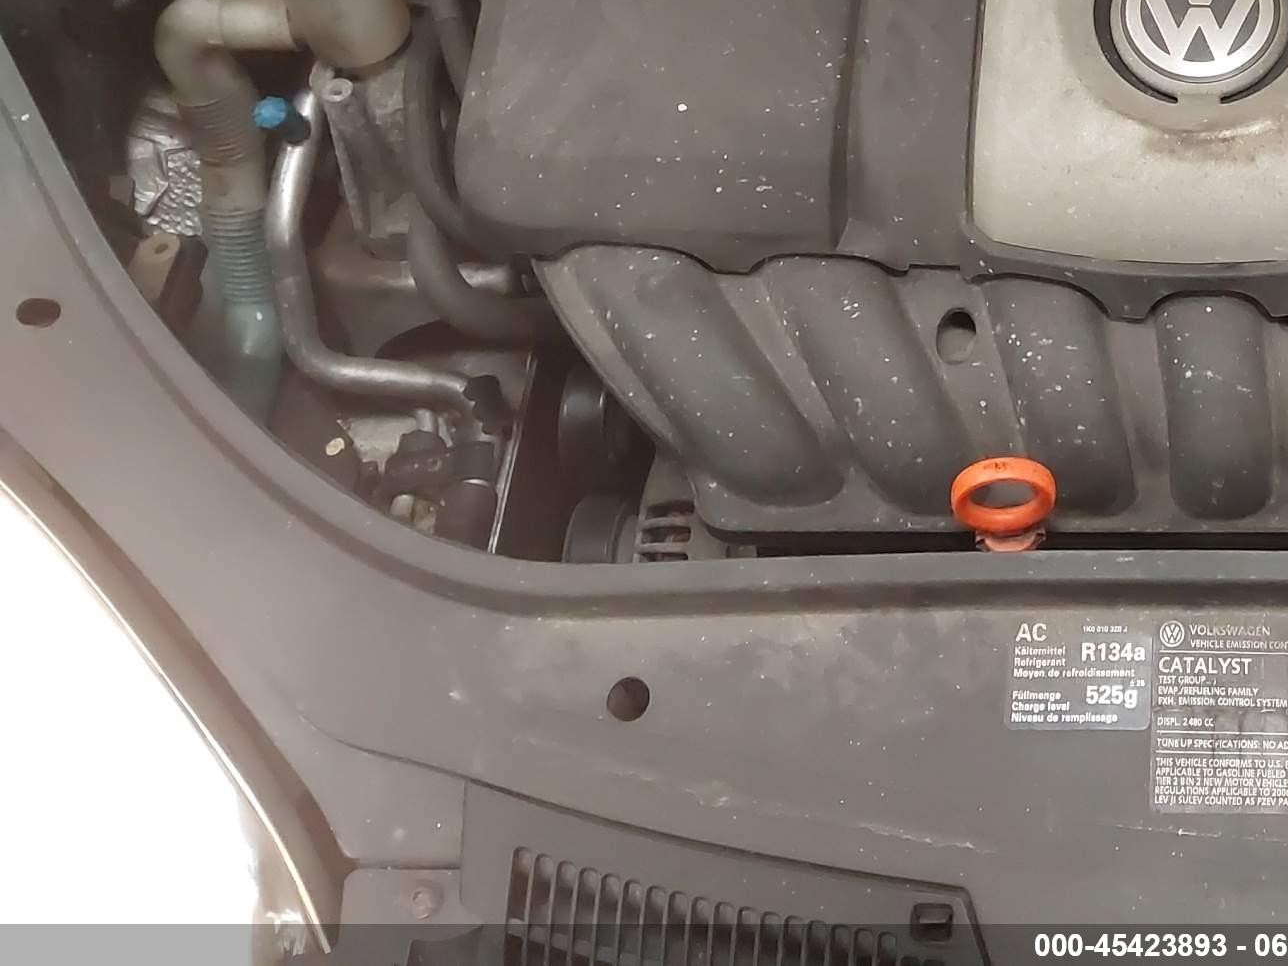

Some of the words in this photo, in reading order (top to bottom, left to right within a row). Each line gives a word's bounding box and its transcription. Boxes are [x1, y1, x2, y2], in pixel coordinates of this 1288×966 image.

[1015, 623, 1048, 642] AC
[1189, 624, 1271, 636] VOLKSWAGEN
[1191, 639, 1224, 648] VEHICLE
[1226, 640, 1267, 650] EMISSION
[1014, 646, 1066, 656] Kältemittel
[1081, 642, 1146, 662] R134a
[1014, 658, 1066, 668] Refrigerant
[1158, 656, 1253, 675] CATALYST
[1013, 668, 1045, 679] Moyen
[1048, 668, 1060, 677] de
[1062, 668, 1136, 678] refroidissement
[1158, 675, 1176, 685] TEST
[1177, 675, 1207, 685] GROUP
[1012, 690, 1061, 701] Füllmenge
[1086, 684, 1138, 709] 525g
[1228, 687, 1259, 697] FAMILY
[1011, 701, 1045, 713] Charge
[1048, 701, 1070, 711] level
[1179, 697, 1216, 707] EMISSION
[1217, 697, 1255, 707] CONTROL
[1256, 698, 1288, 708] SYSTEM
[1011, 712, 1044, 723] Niveau
[1047, 713, 1059, 723] de
[1061, 713, 1118, 724] remplissage
[1204, 717, 1215, 727] CC
[1157, 738, 1179, 748] TUNE
[1180, 738, 1193, 748] UP
[1262, 740, 1276, 750] NO
[1156, 757, 1173, 767] THIS
[1175, 758, 1207, 768] VEHICLE
[1208, 759, 1253, 769] CONFORMS
[1254, 759, 1266, 769] TO
[1267, 760, 1284, 770] U.S.
[1155, 767, 1201, 777] APPLICABLE
[1203, 769, 1214, 777] TO
[1216, 769, 1256, 779] GASOLINE
[1257, 770, 1286, 779] FUELED
[1156, 777, 1171, 786] TIER
[1172, 777, 1178, 786] 2
[1195, 778, 1201, 787] 2
[1203, 778, 1223, 788] NEW
[1224, 779, 1254, 788] MOTOR
[1155, 786, 1209, 796] REGULATIONS
[1211, 787, 1257, 797] APPLICABLE
[1259, 788, 1270, 797] TO
[1154, 795, 1168, 805] LEV
[1178, 796, 1203, 805] SULEV
[1204, 796, 1243, 806] COUNTED
[1244, 797, 1256, 807] AS
[1257, 797, 1276, 807] PZEV
